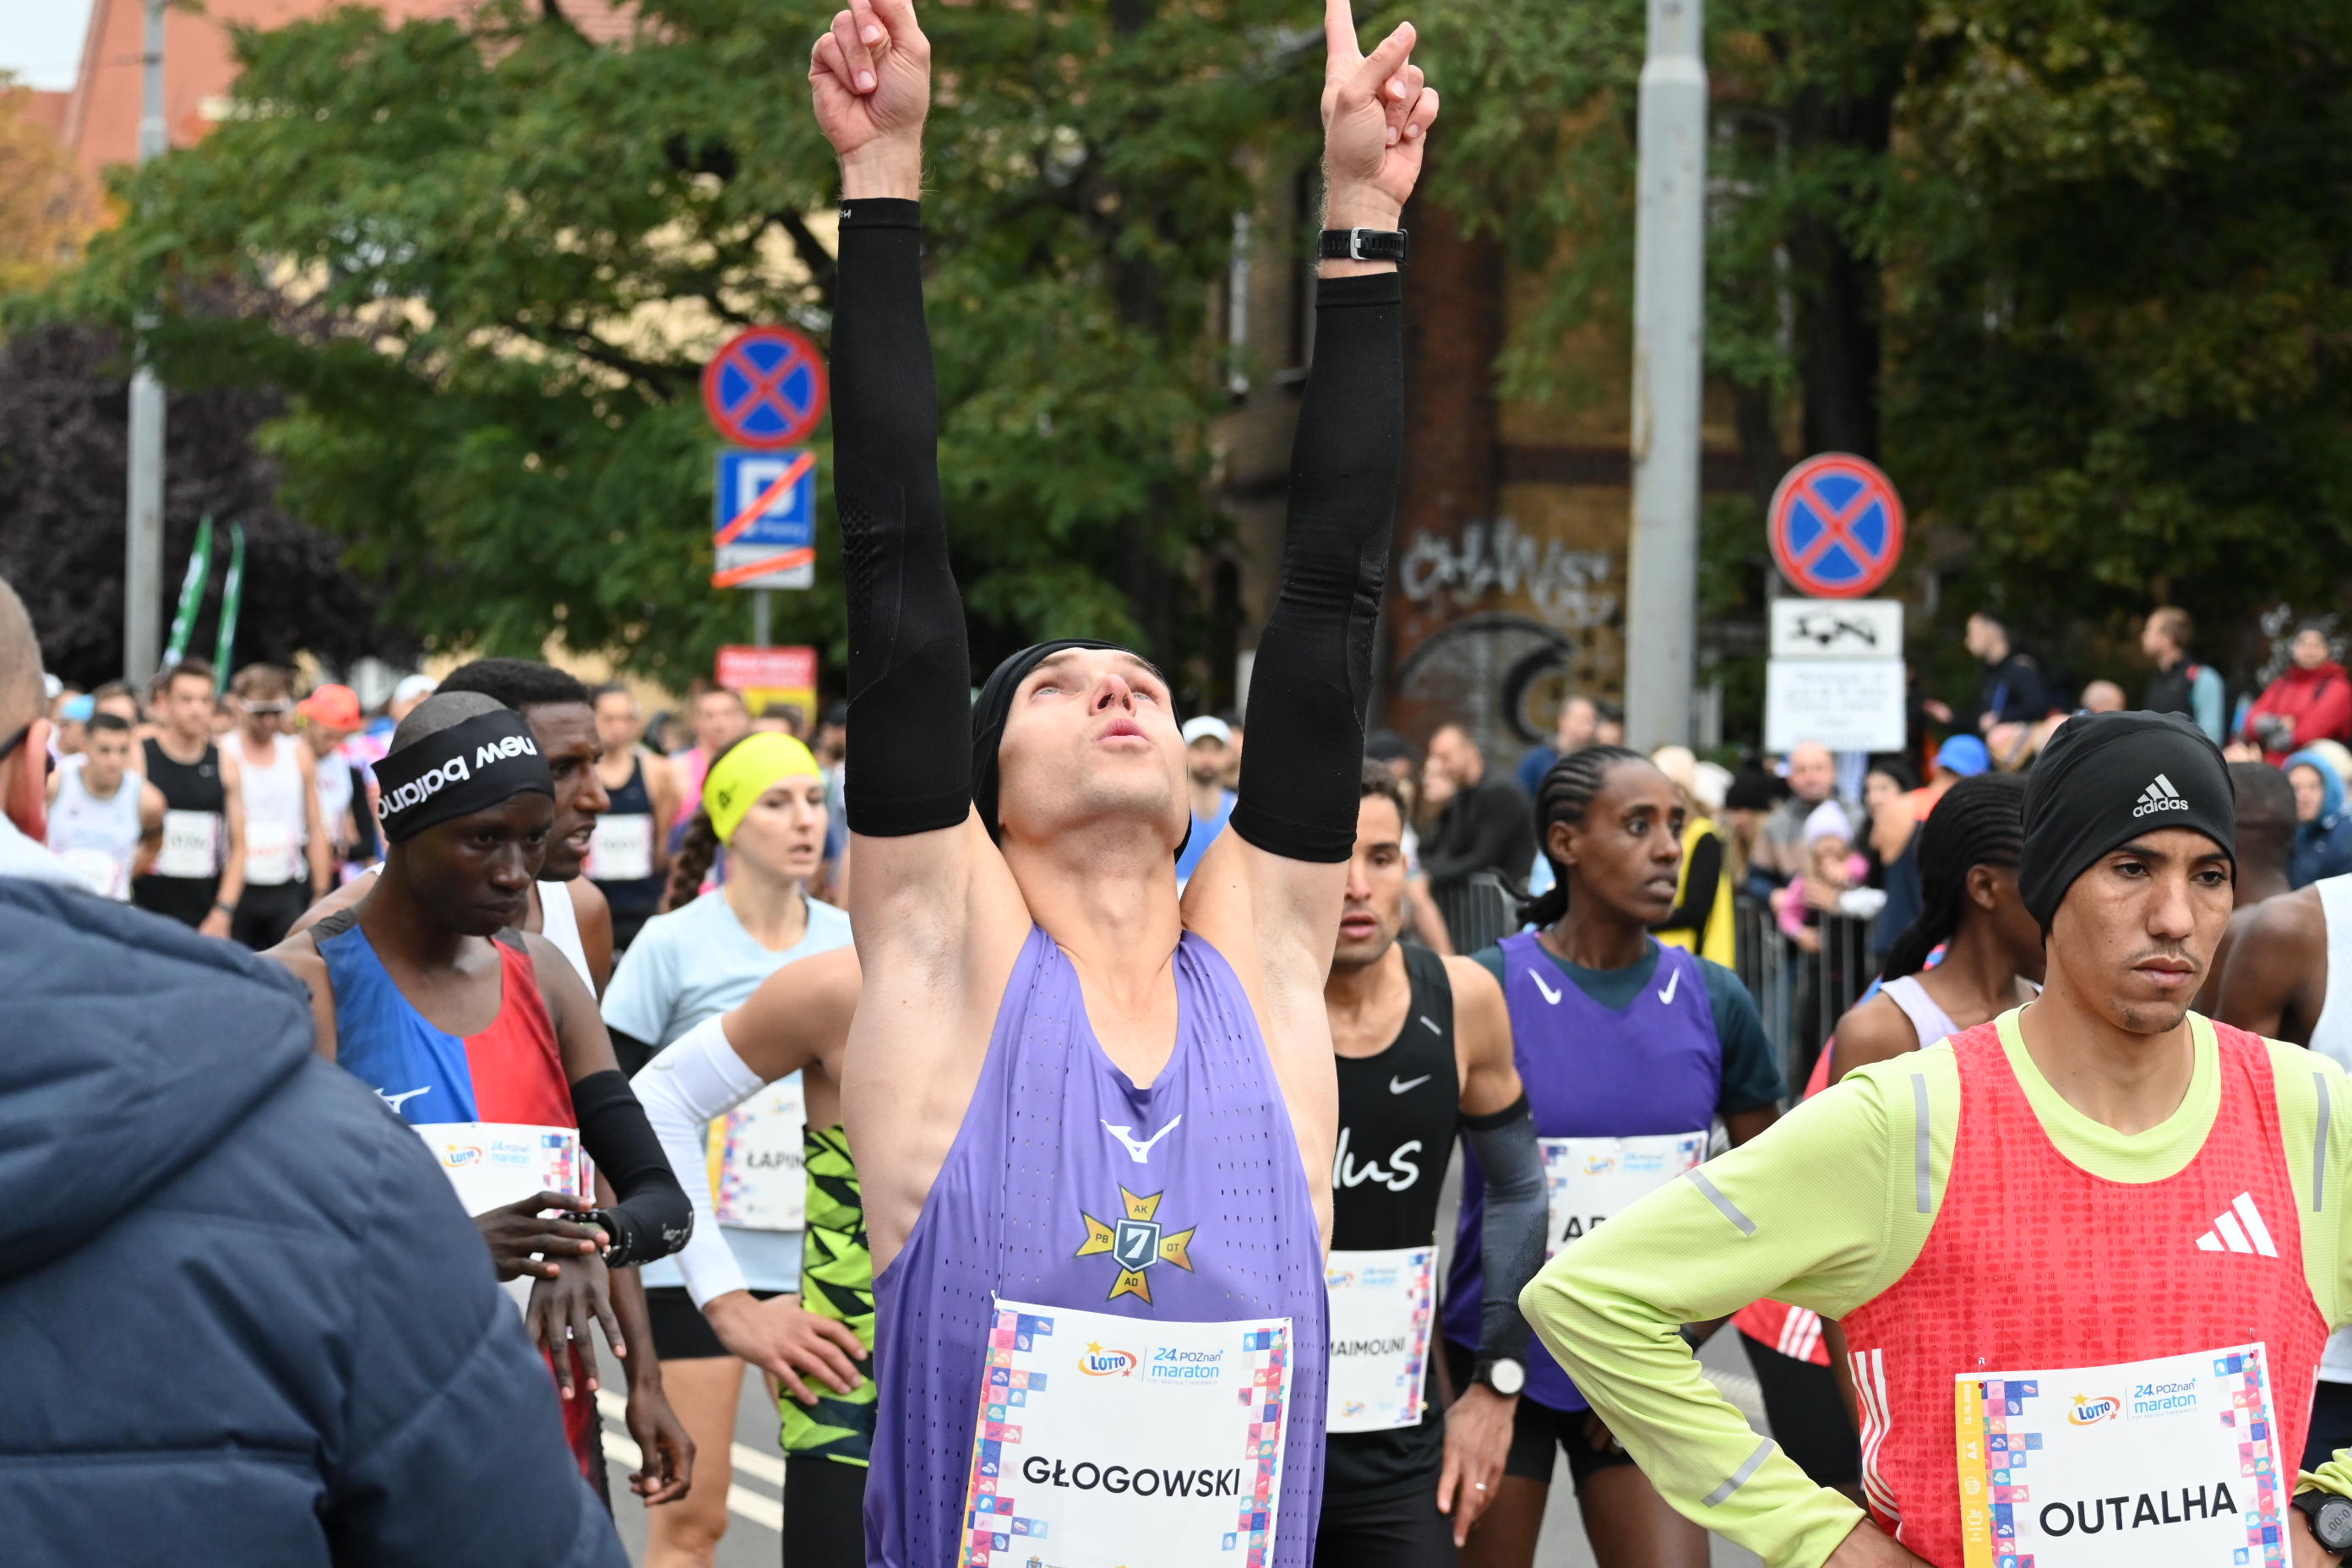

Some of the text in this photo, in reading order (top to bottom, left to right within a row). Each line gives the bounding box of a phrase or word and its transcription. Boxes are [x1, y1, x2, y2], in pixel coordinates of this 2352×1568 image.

[476, 736, 538, 769] new
[2132, 797, 2189, 818] adidas
[1134, 1205, 1148, 1214] AK
[1095, 1233, 1109, 1244] PB
[1124, 1228, 1151, 1259] 7
[1124, 1277, 1139, 1287] AD
[1153, 1348, 1178, 1362] 24.
[1330, 1337, 1405, 1356] AIMOUNI
[1091, 1355, 1125, 1371] LOTTO
[1152, 1364, 1219, 1379] maraton
[2134, 1384, 2155, 1398] 24.
[2078, 1402, 2110, 1421] LOTTO
[2134, 1394, 2197, 1413] maraton
[1022, 1456, 1240, 1497] GŁOGOWSKI
[2039, 1482, 2238, 1537] OUTALHA
